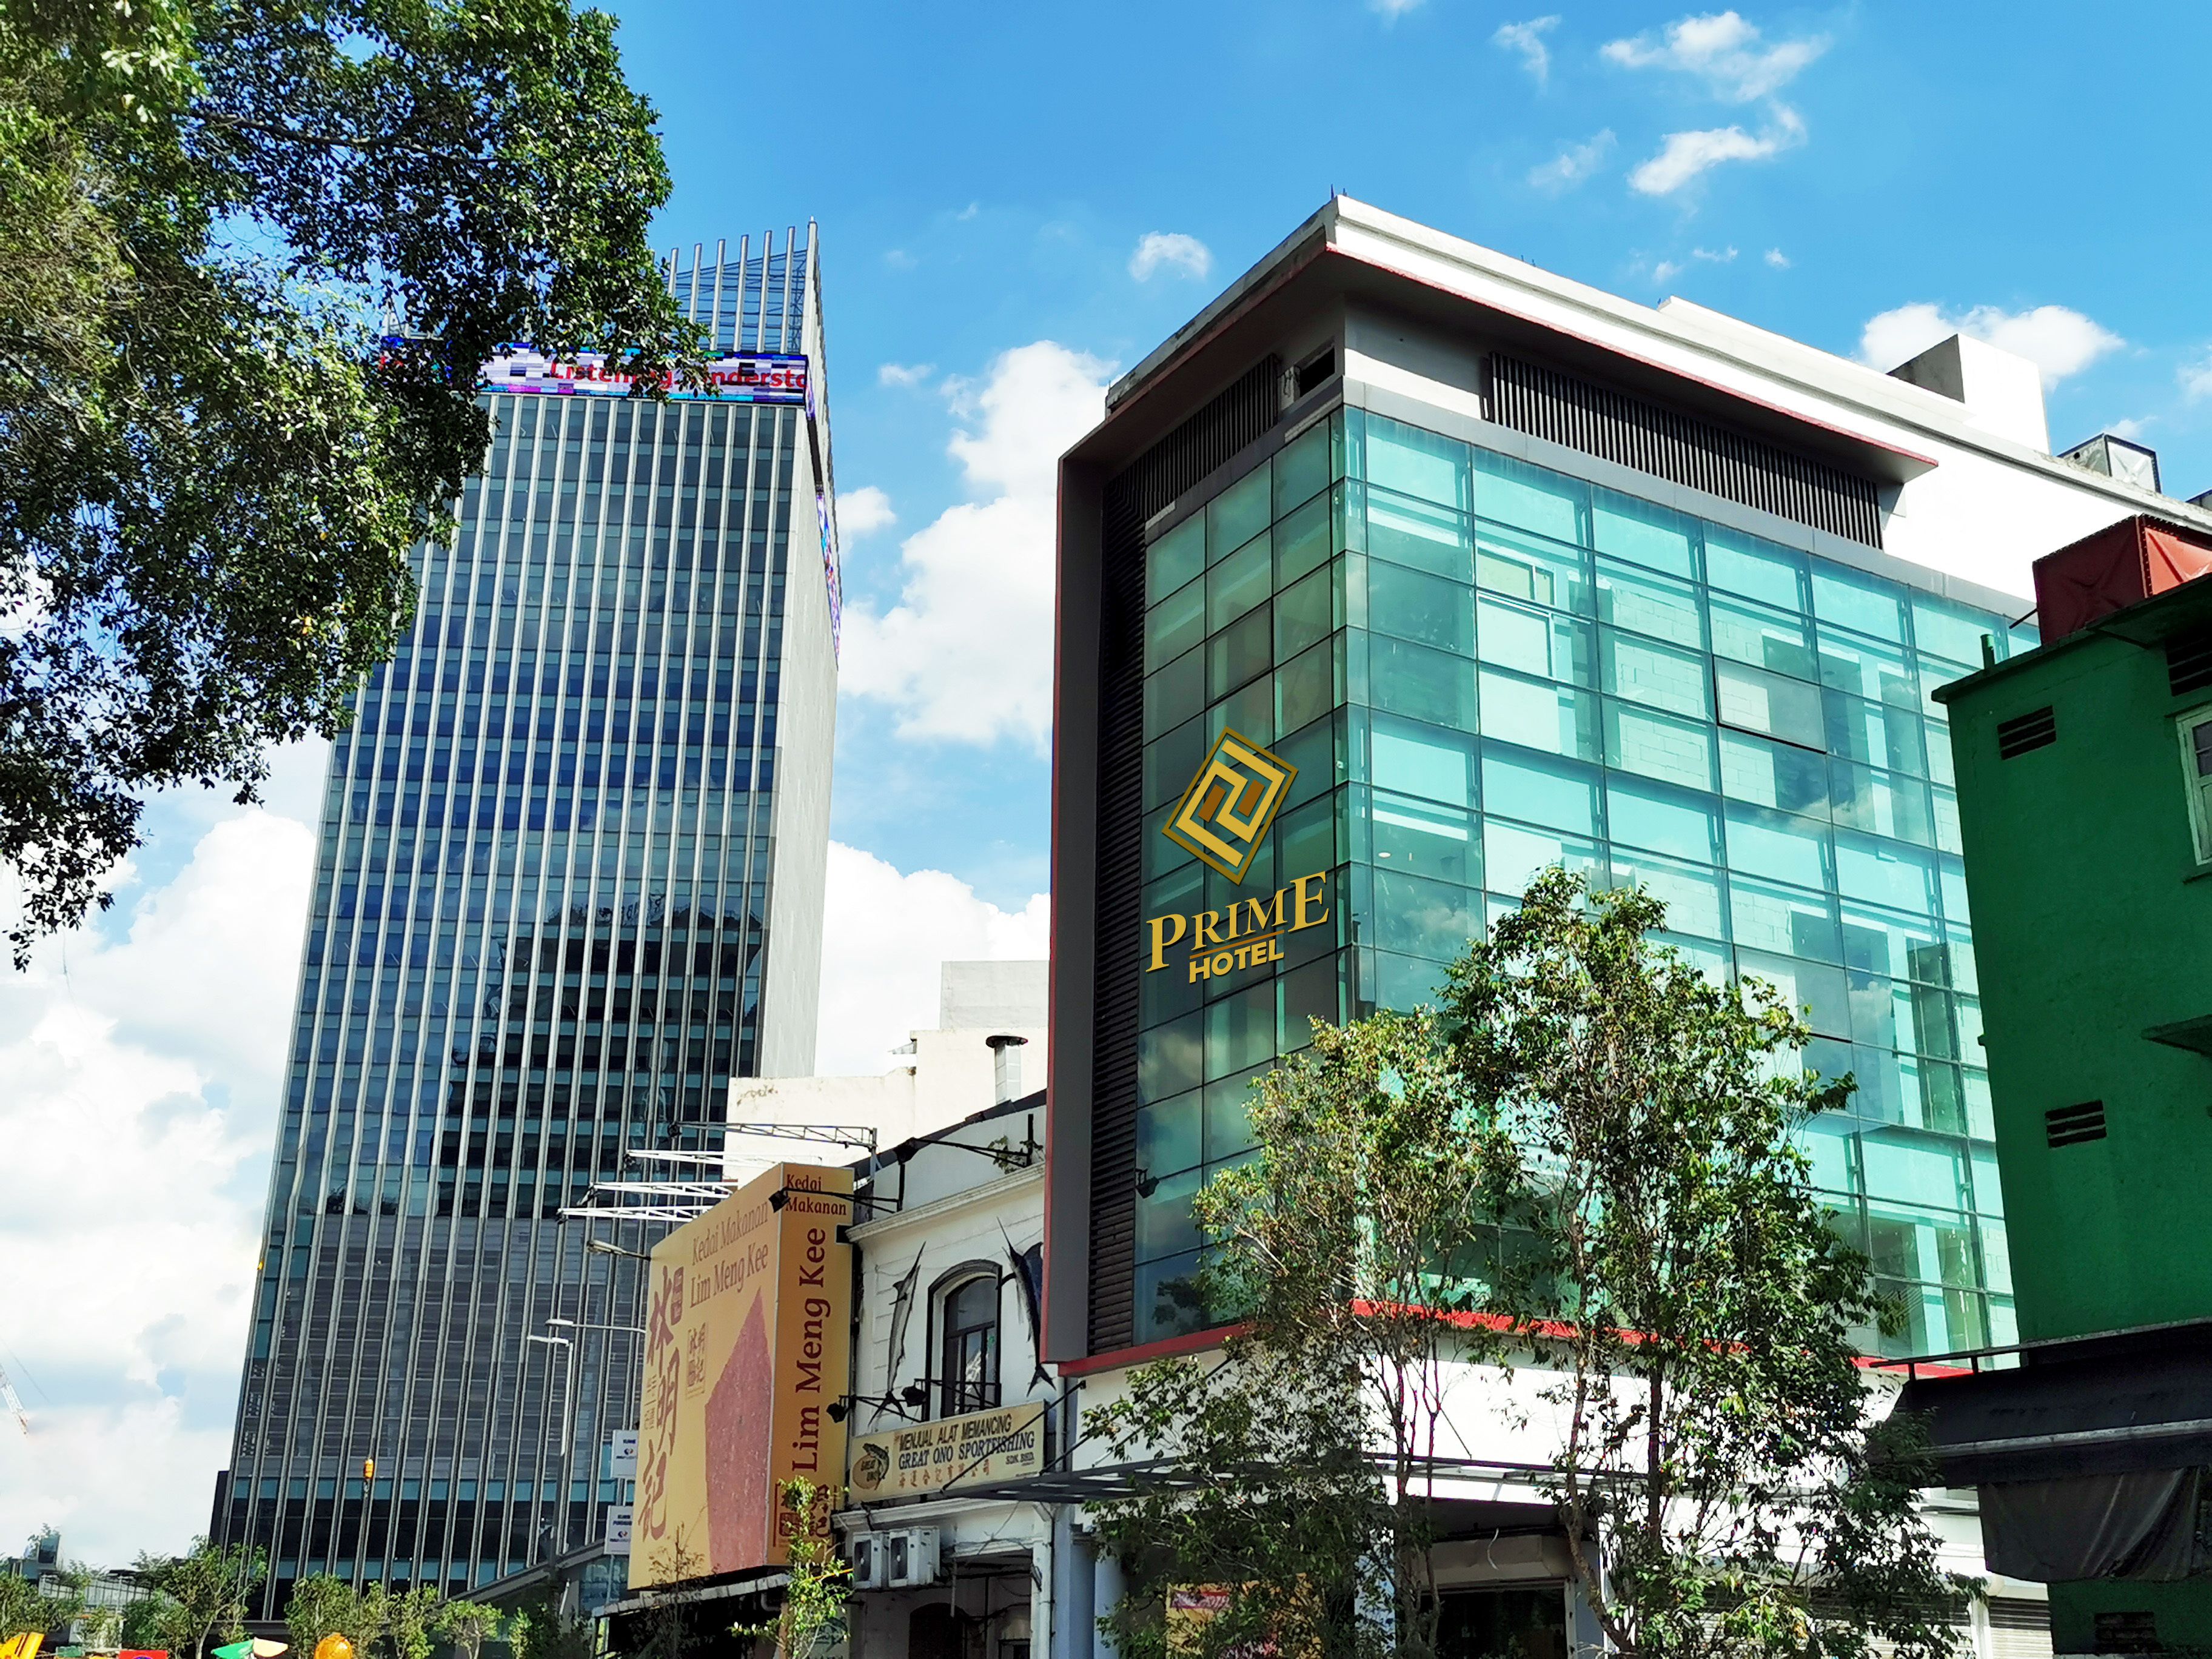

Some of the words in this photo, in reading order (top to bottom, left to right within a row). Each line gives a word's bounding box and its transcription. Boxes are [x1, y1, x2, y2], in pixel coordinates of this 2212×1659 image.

[1146, 871, 1329, 972] PRIME
[1189, 939, 1284, 984] HOTEL
[786, 1174, 822, 1191] Kedai
[786, 1196, 846, 1215] Makanan
[692, 1224, 719, 1265] Kedai
[720, 1202, 768, 1249] Makanan
[799, 1228, 825, 1287] Kee
[690, 1274, 711, 1308] Lim
[713, 1258, 745, 1293] Meng
[747, 1242, 768, 1278] Kee
[796, 1298, 831, 1393] Meng
[792, 1406, 819, 1472] Lim
[899, 1450, 930, 1470] GREAT
[933, 1446, 953, 1464] ONO
[958, 1431, 1034, 1460] SPORTFISHING
[900, 1429, 933, 1452] MENJUAL
[937, 1424, 959, 1446] ALAT
[961, 1413, 1012, 1440] MEMANCING
